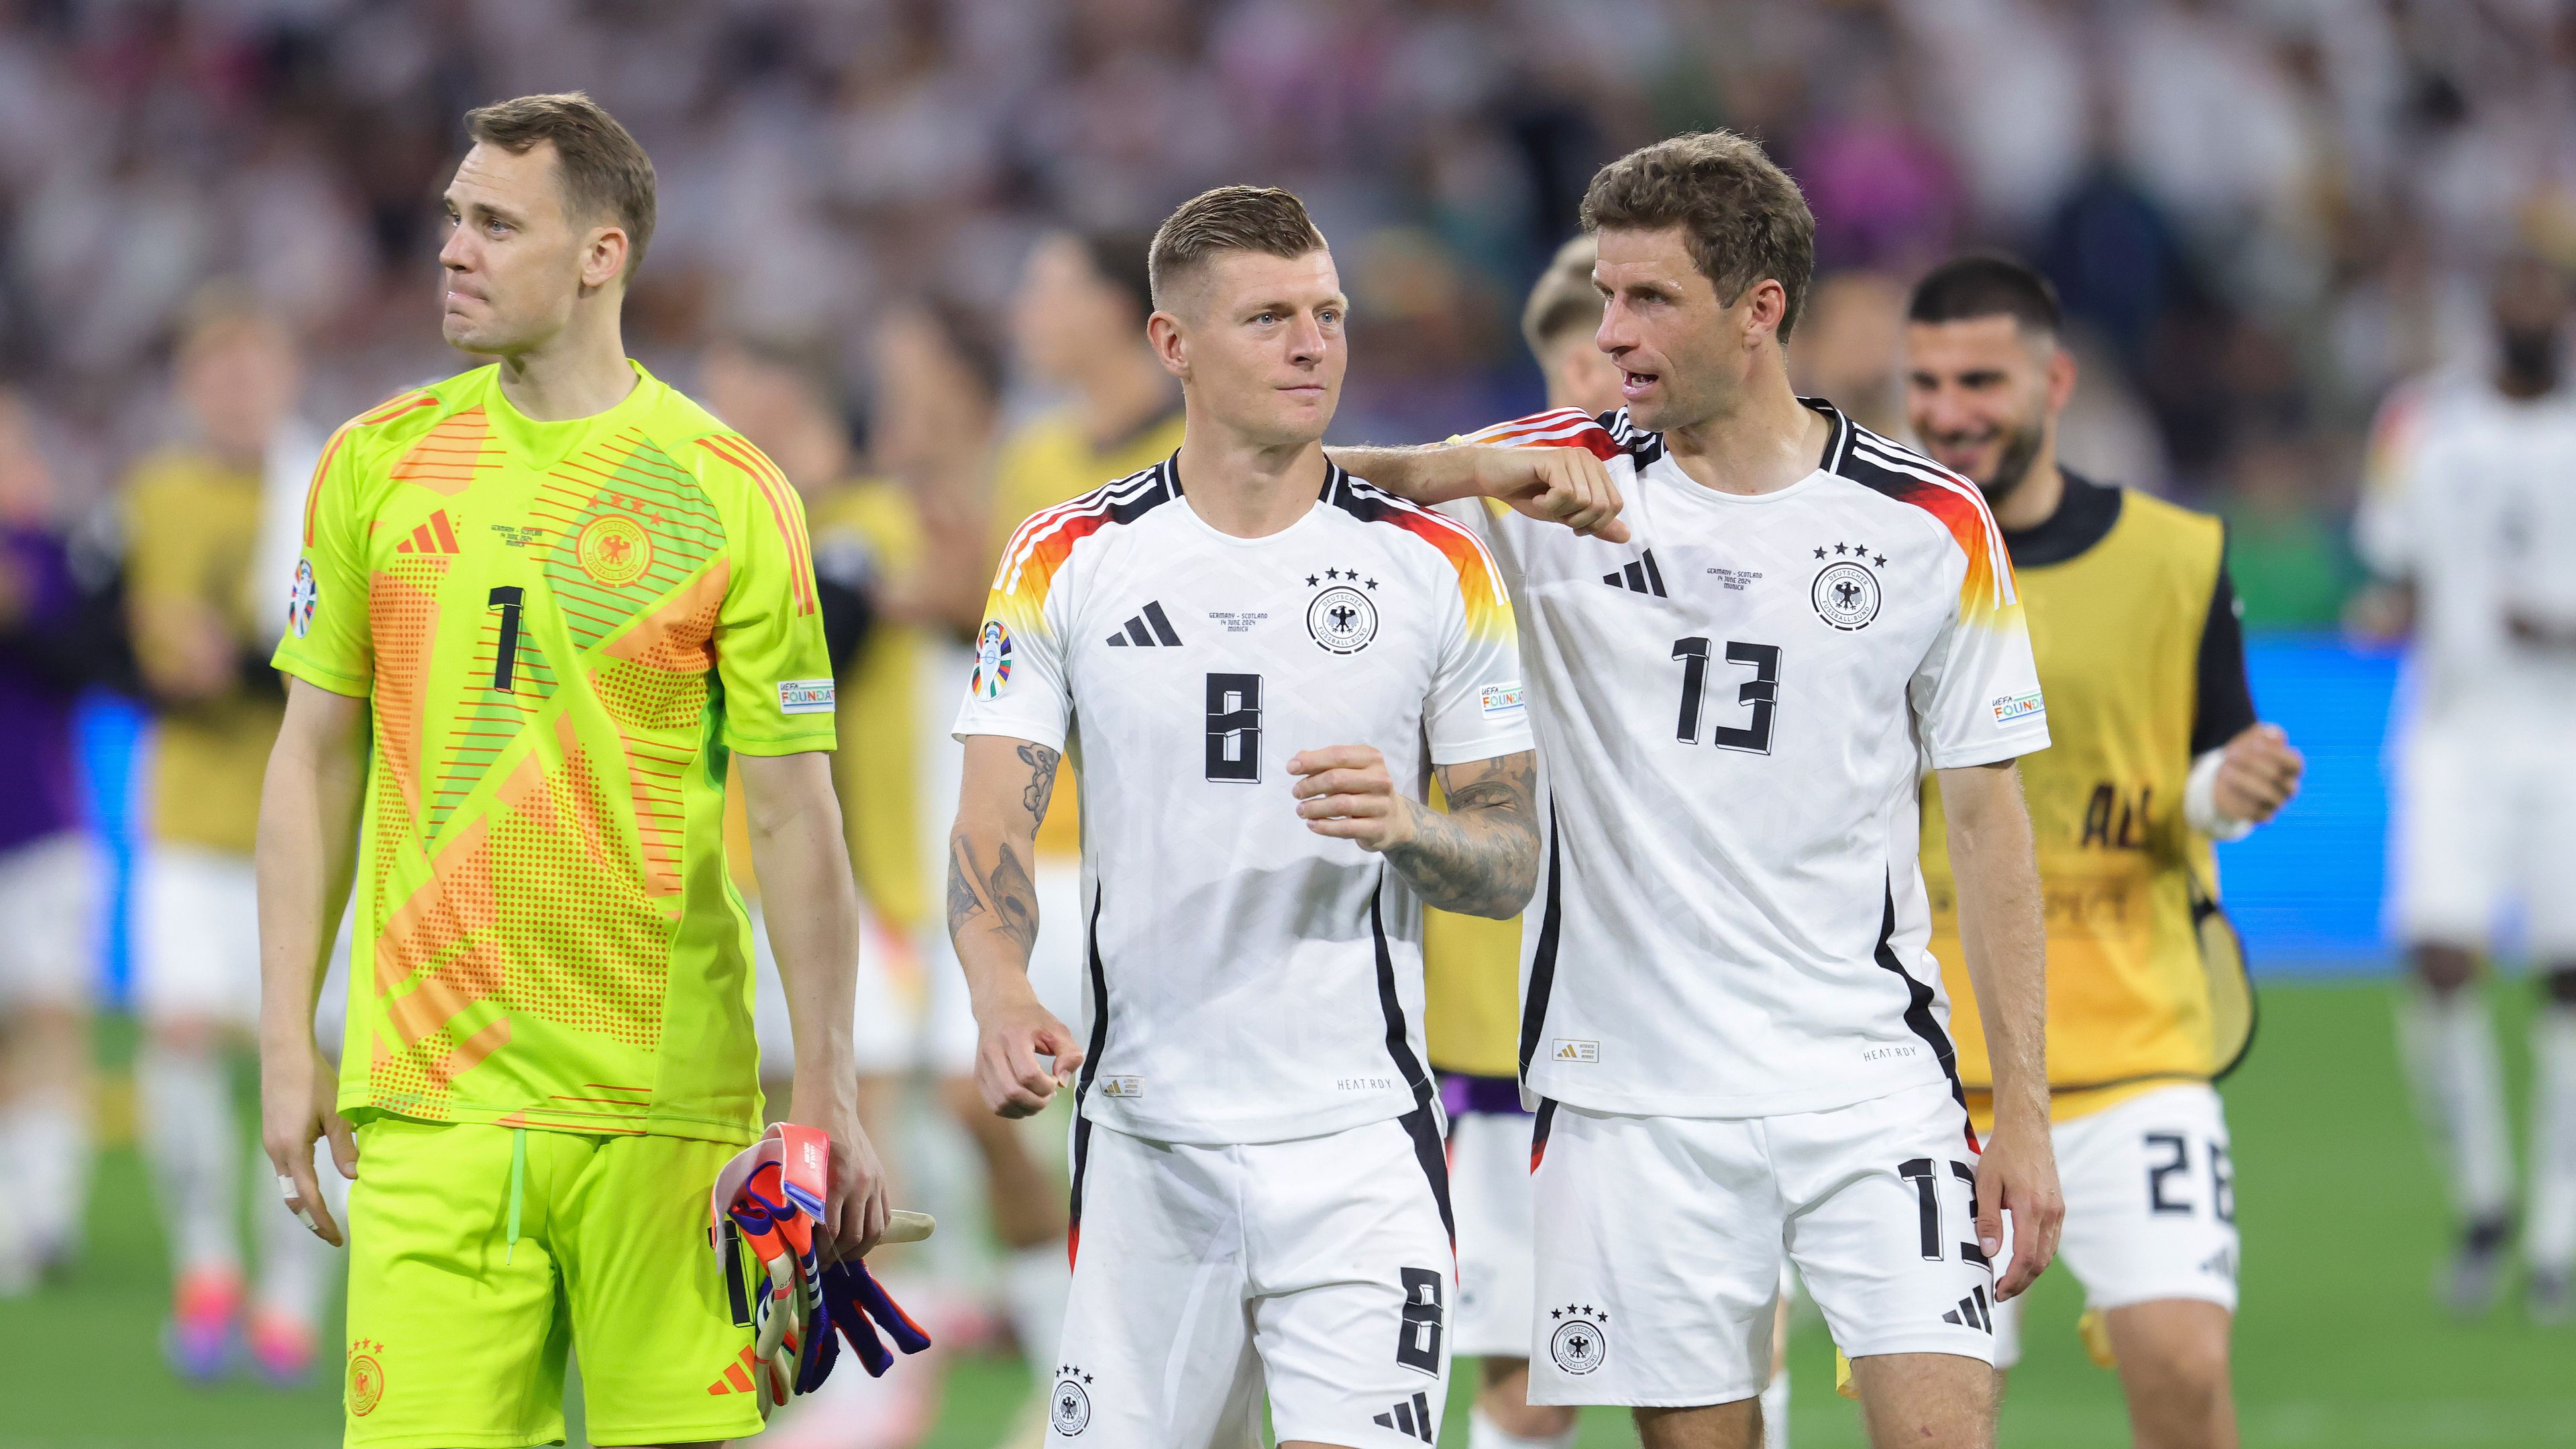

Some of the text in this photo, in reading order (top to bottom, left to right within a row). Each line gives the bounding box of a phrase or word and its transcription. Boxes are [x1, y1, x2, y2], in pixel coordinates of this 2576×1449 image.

[1828, 570, 1868, 585] DEUTSCHER
[1322, 594, 1362, 607] DEUTSCHER
[1822, 600, 1870, 622] FUSSBALL-BUND
[488, 586, 525, 695] 1
[1318, 627, 1367, 645] FUSSBALL-BUND
[1481, 686, 1498, 695] UEFA
[1672, 637, 1782, 756] 13
[1992, 696, 2012, 706] UEFA
[1205, 673, 1264, 784] 8
[1898, 1159, 1992, 1273] 13
[1397, 1267, 1443, 1380] 8
[1563, 1327, 1595, 1338] DEUTSCHER
